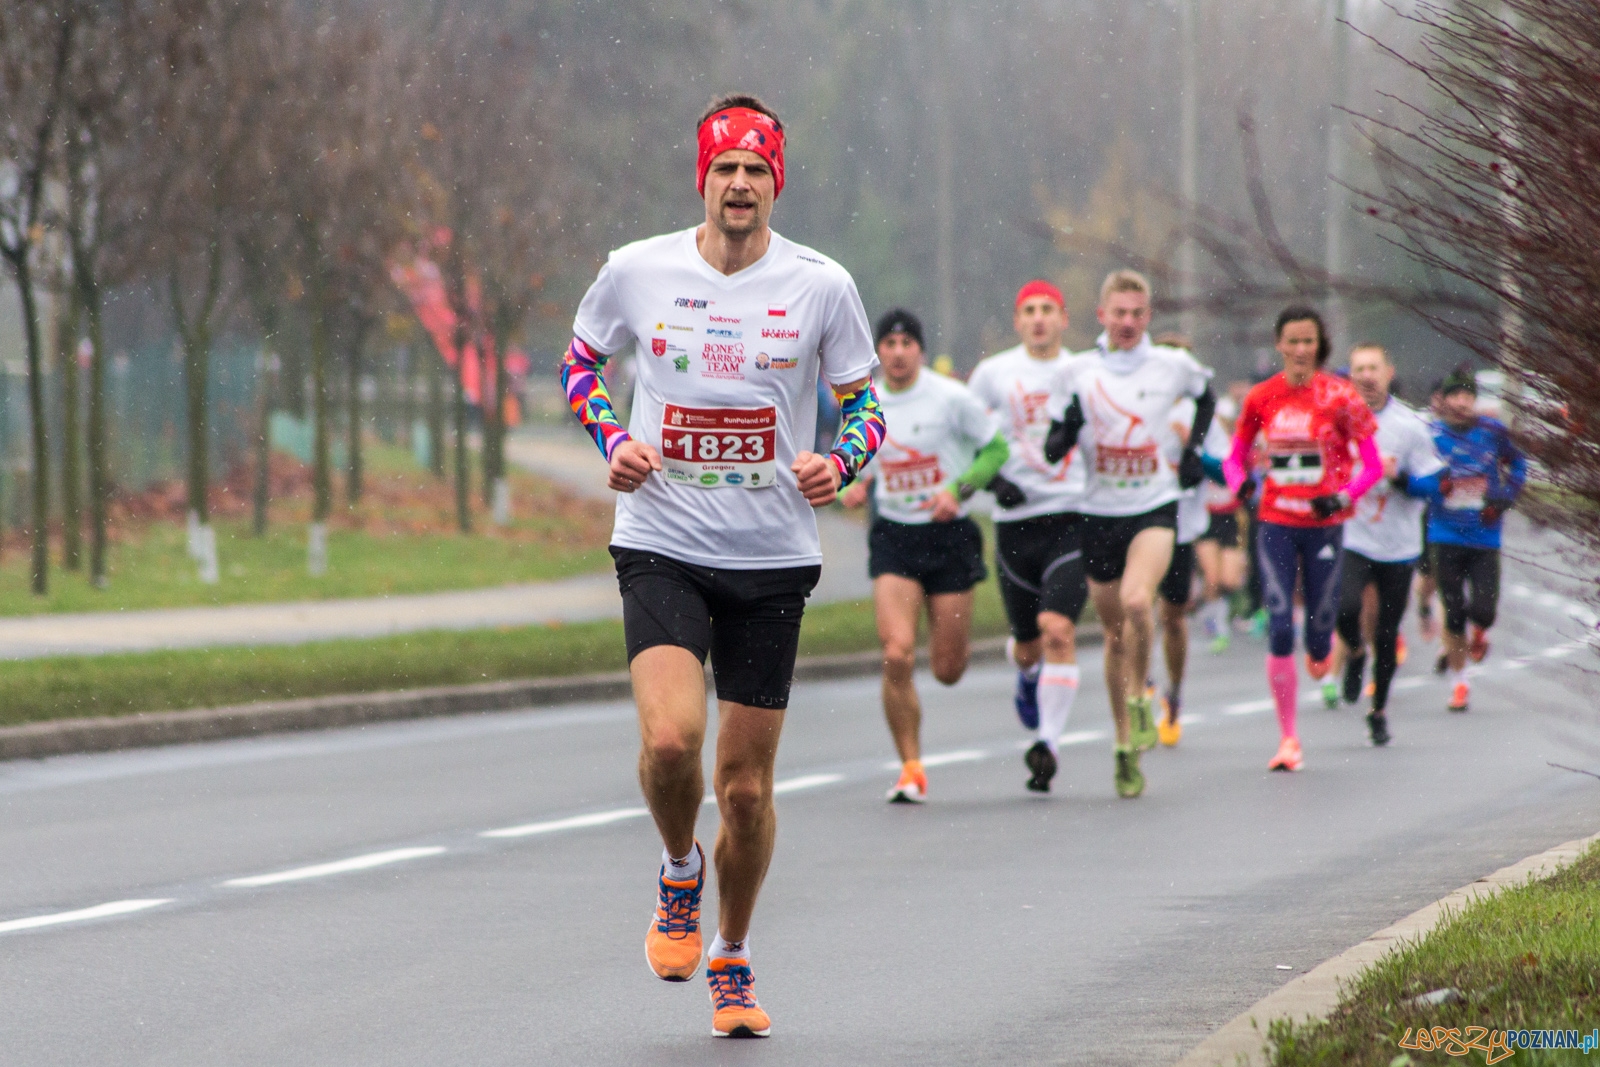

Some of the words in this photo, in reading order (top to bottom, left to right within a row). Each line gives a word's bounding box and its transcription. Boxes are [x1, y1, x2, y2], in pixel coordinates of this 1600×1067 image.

[704, 343, 734, 354] BONE
[702, 352, 746, 364] MARROW
[706, 361, 739, 373] TEAM
[723, 416, 770, 425] RunPoland.org
[664, 439, 672, 449] B
[677, 434, 765, 461] 1823
